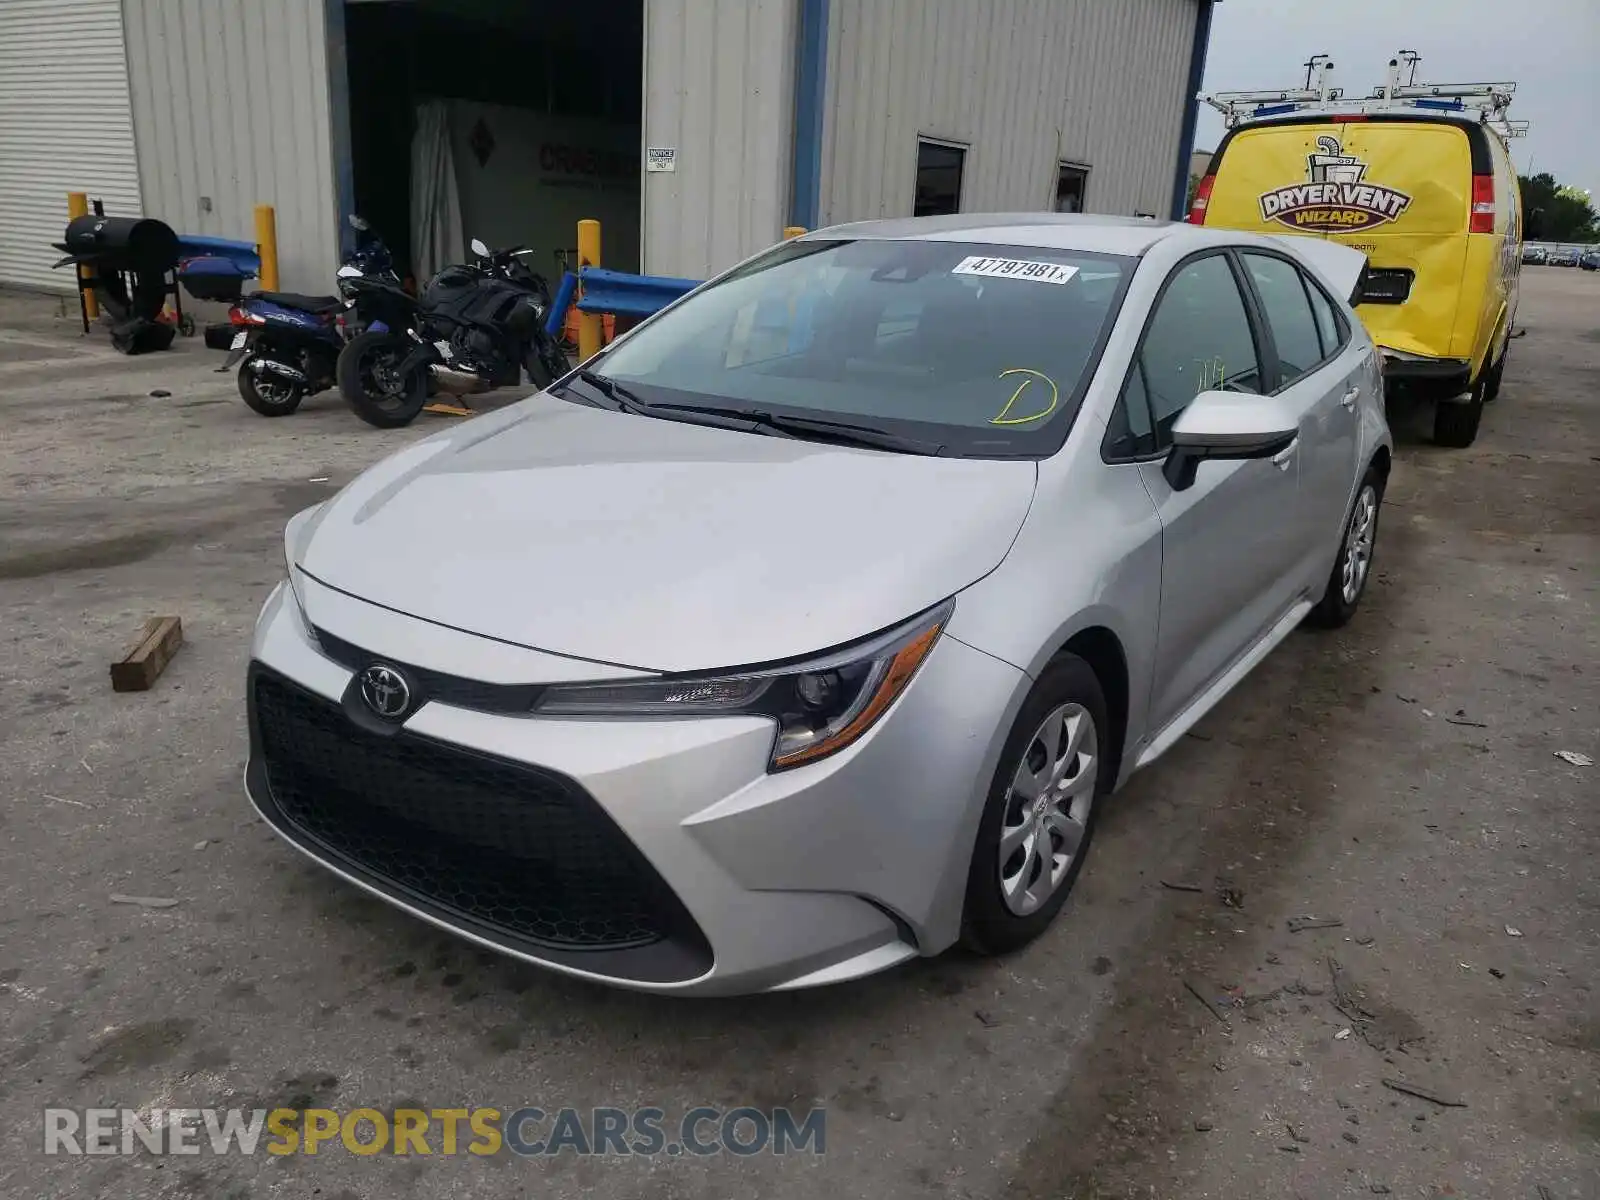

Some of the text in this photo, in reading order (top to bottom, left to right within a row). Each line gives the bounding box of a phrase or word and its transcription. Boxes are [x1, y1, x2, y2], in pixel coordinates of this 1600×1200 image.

[1263, 184, 1406, 215] DRYER VENT
[1295, 210, 1369, 225] WIZARD
[971, 258, 1061, 279] 47797981
[986, 368, 1057, 424] D
